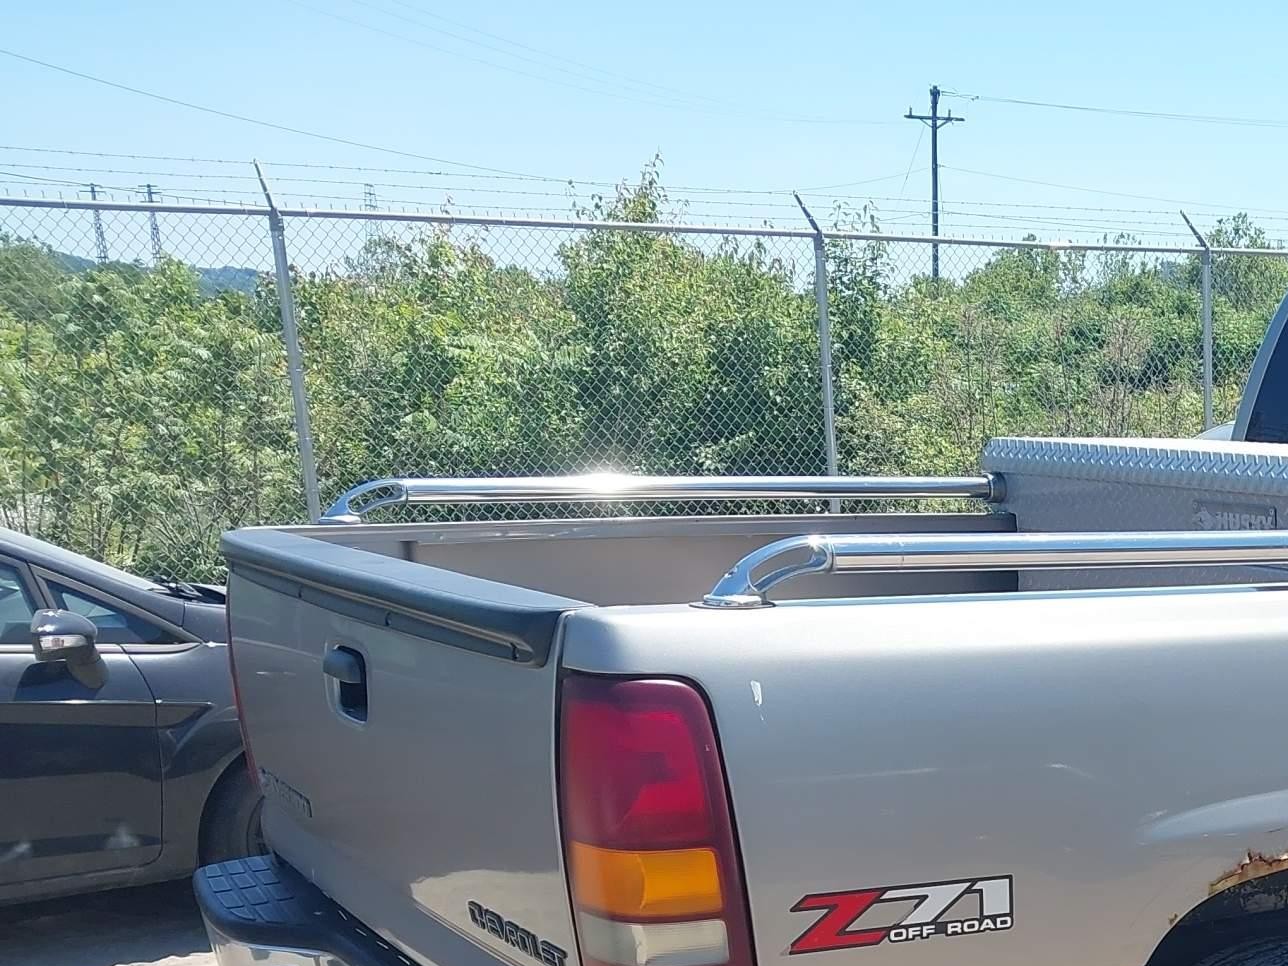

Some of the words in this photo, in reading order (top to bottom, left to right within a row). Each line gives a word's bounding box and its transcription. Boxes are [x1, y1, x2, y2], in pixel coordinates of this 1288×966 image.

[789, 874, 1013, 955] Z71
[889, 925, 936, 942] OFF
[946, 916, 1012, 936] ROAD
